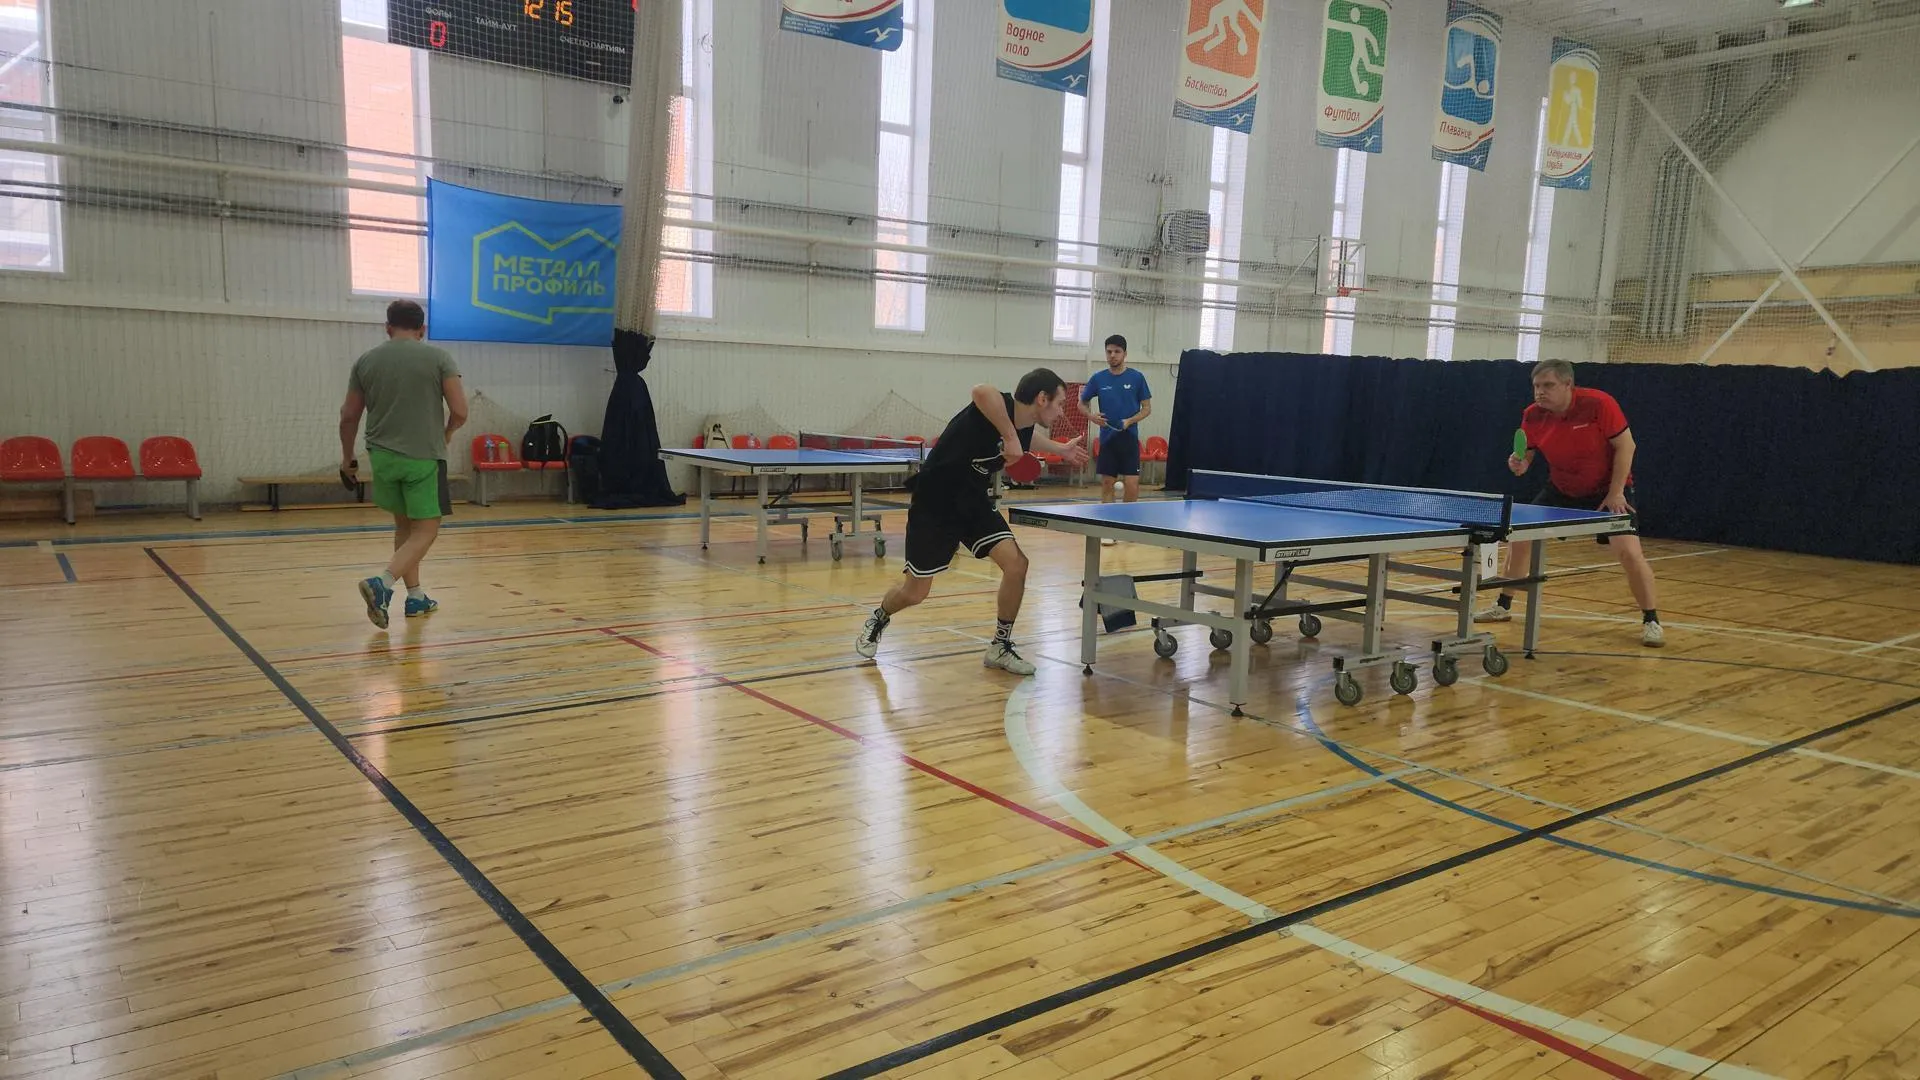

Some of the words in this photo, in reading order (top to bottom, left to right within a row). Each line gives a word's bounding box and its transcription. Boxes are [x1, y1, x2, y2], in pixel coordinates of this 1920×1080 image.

[425, 7, 452, 19] ФОЛЫ
[429, 20, 447, 48] 0
[1006, 22, 1045, 43] Водное
[591, 41, 626, 55] ПАРТИЯМ
[1005, 42, 1030, 57] поло
[1184, 76, 1229, 98] Баскетбол
[1324, 105, 1361, 122] Футбол
[1440, 121, 1473, 140] Плавание
[493, 253, 600, 279] МЕТАЛЛ
[493, 274, 606, 296] ПРОФИЛЬ
[1487, 552, 1494, 569] 6
